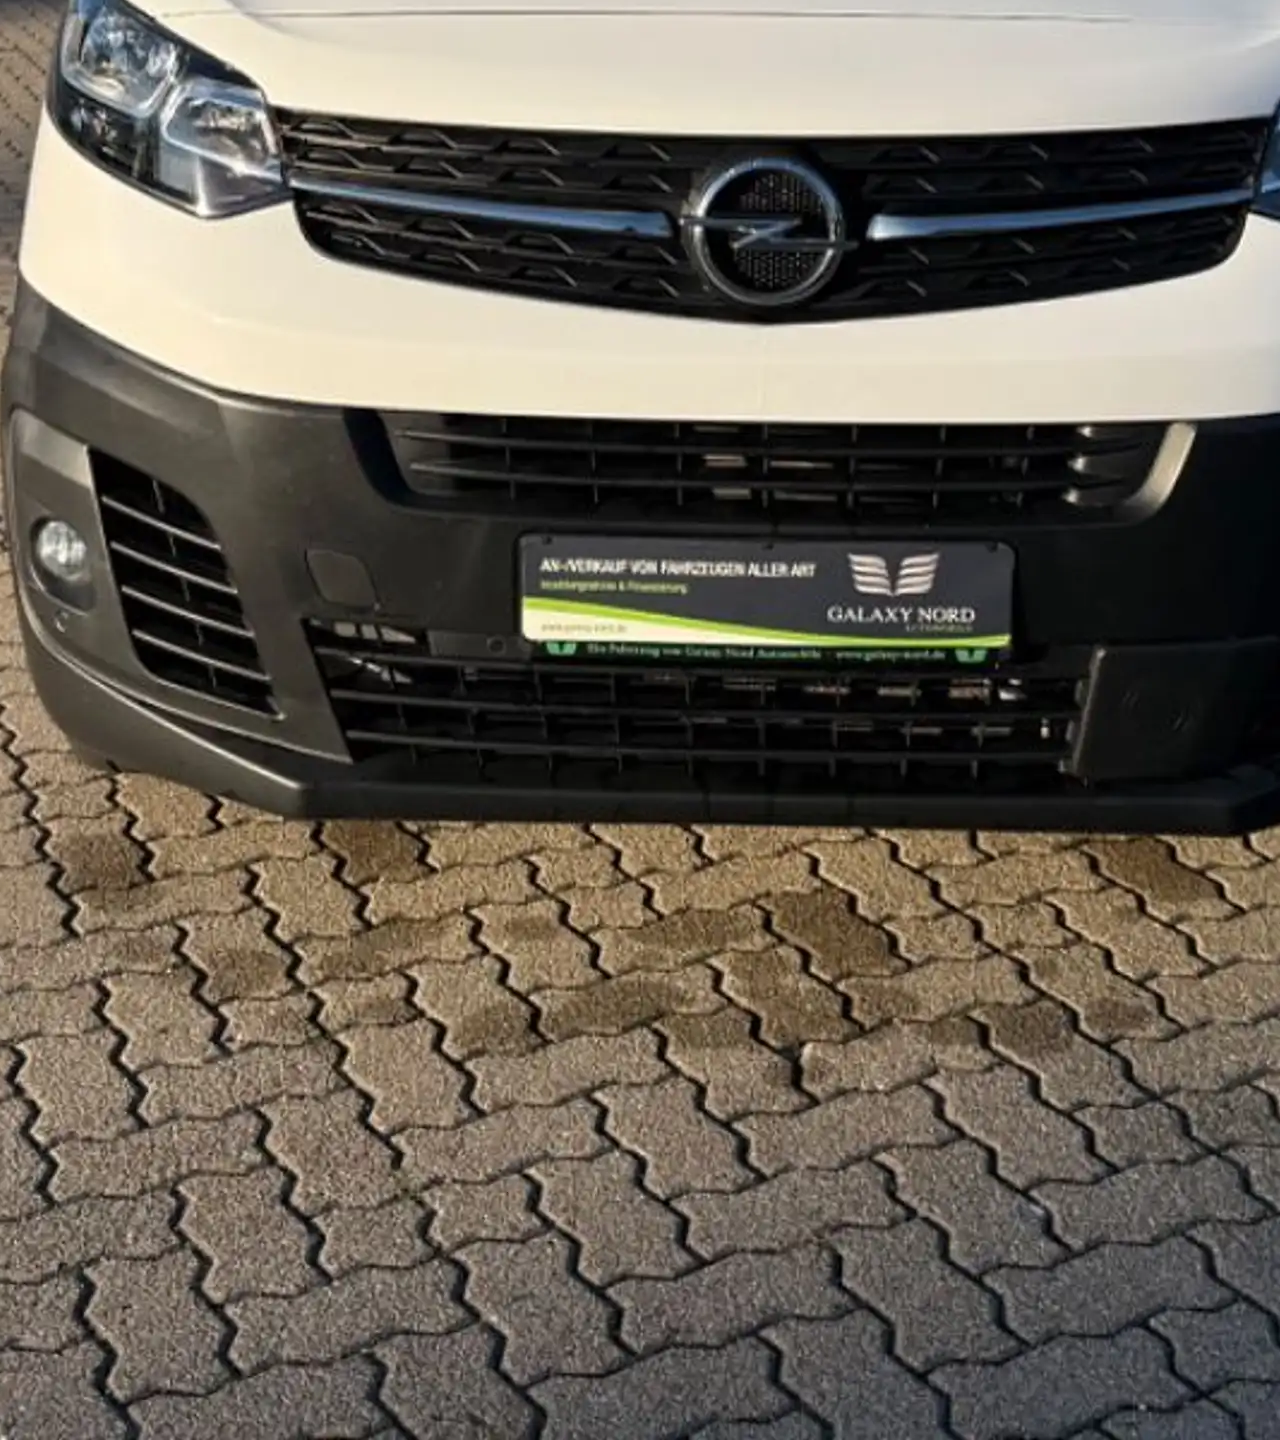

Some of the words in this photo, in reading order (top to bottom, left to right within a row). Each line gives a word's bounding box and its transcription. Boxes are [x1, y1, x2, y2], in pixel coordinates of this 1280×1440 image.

[630, 558, 658, 575] VON
[661, 559, 746, 577] FAHRZEUGEN
[748, 561, 789, 578] ALLER
[791, 562, 817, 578] ART
[826, 606, 913, 623] GALAXY
[917, 606, 976, 623] NORD
[726, 645, 754, 657] Nord
